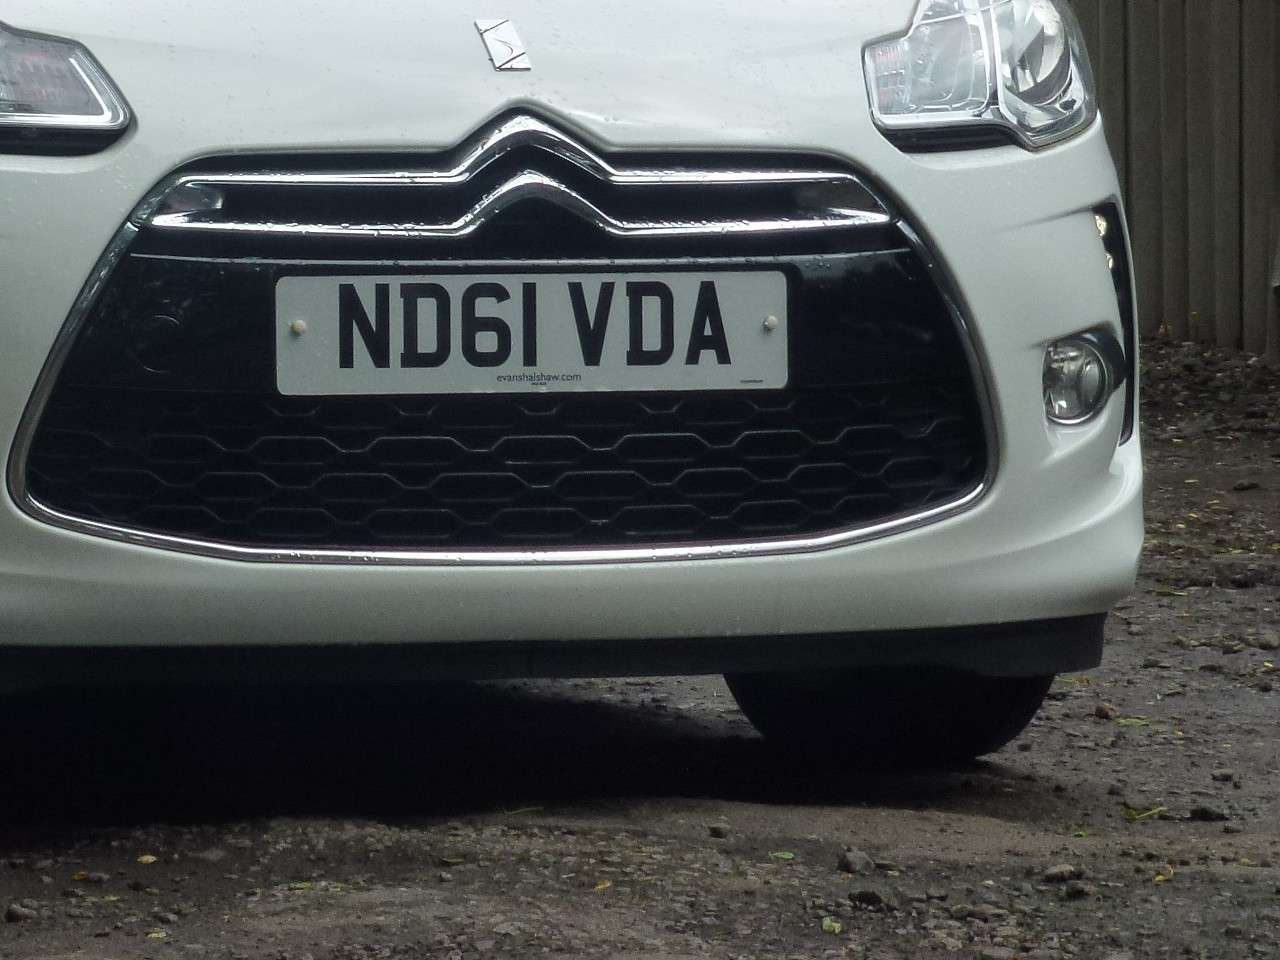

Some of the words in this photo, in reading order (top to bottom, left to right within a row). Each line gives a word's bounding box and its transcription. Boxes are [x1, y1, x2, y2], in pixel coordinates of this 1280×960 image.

[338, 281, 538, 369] ND61
[567, 280, 732, 367] VDA
[496, 371, 582, 382] evanshalshaw.com
